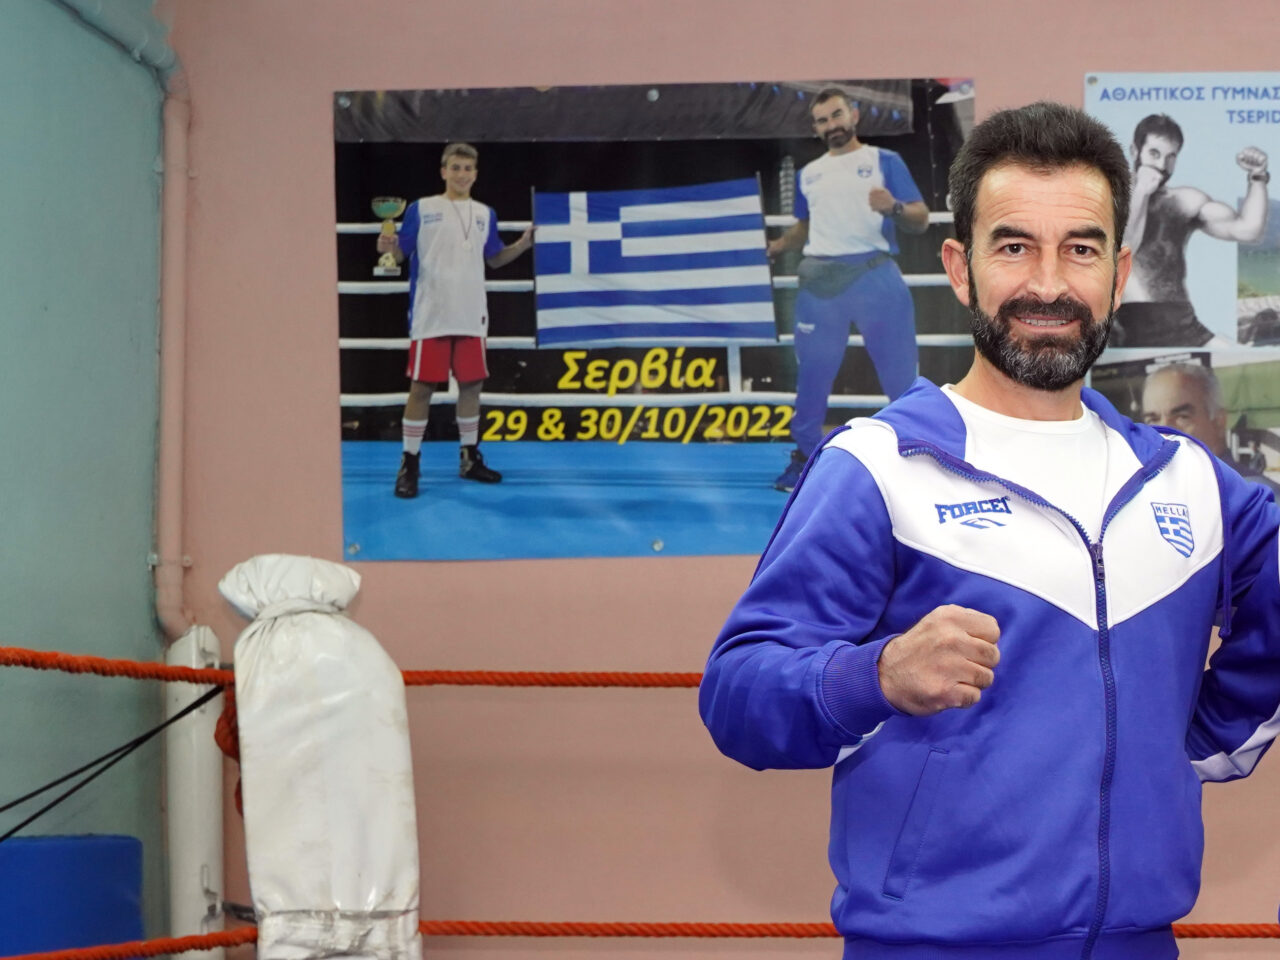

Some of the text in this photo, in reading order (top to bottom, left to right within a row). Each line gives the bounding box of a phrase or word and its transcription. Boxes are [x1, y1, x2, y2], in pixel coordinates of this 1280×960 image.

[1099, 86, 1205, 101] ΑΘΛΗΤΙΚΟΣ
[557, 347, 717, 397] Σερβία
[482, 403, 795, 445] 29 & 30/10/2022
